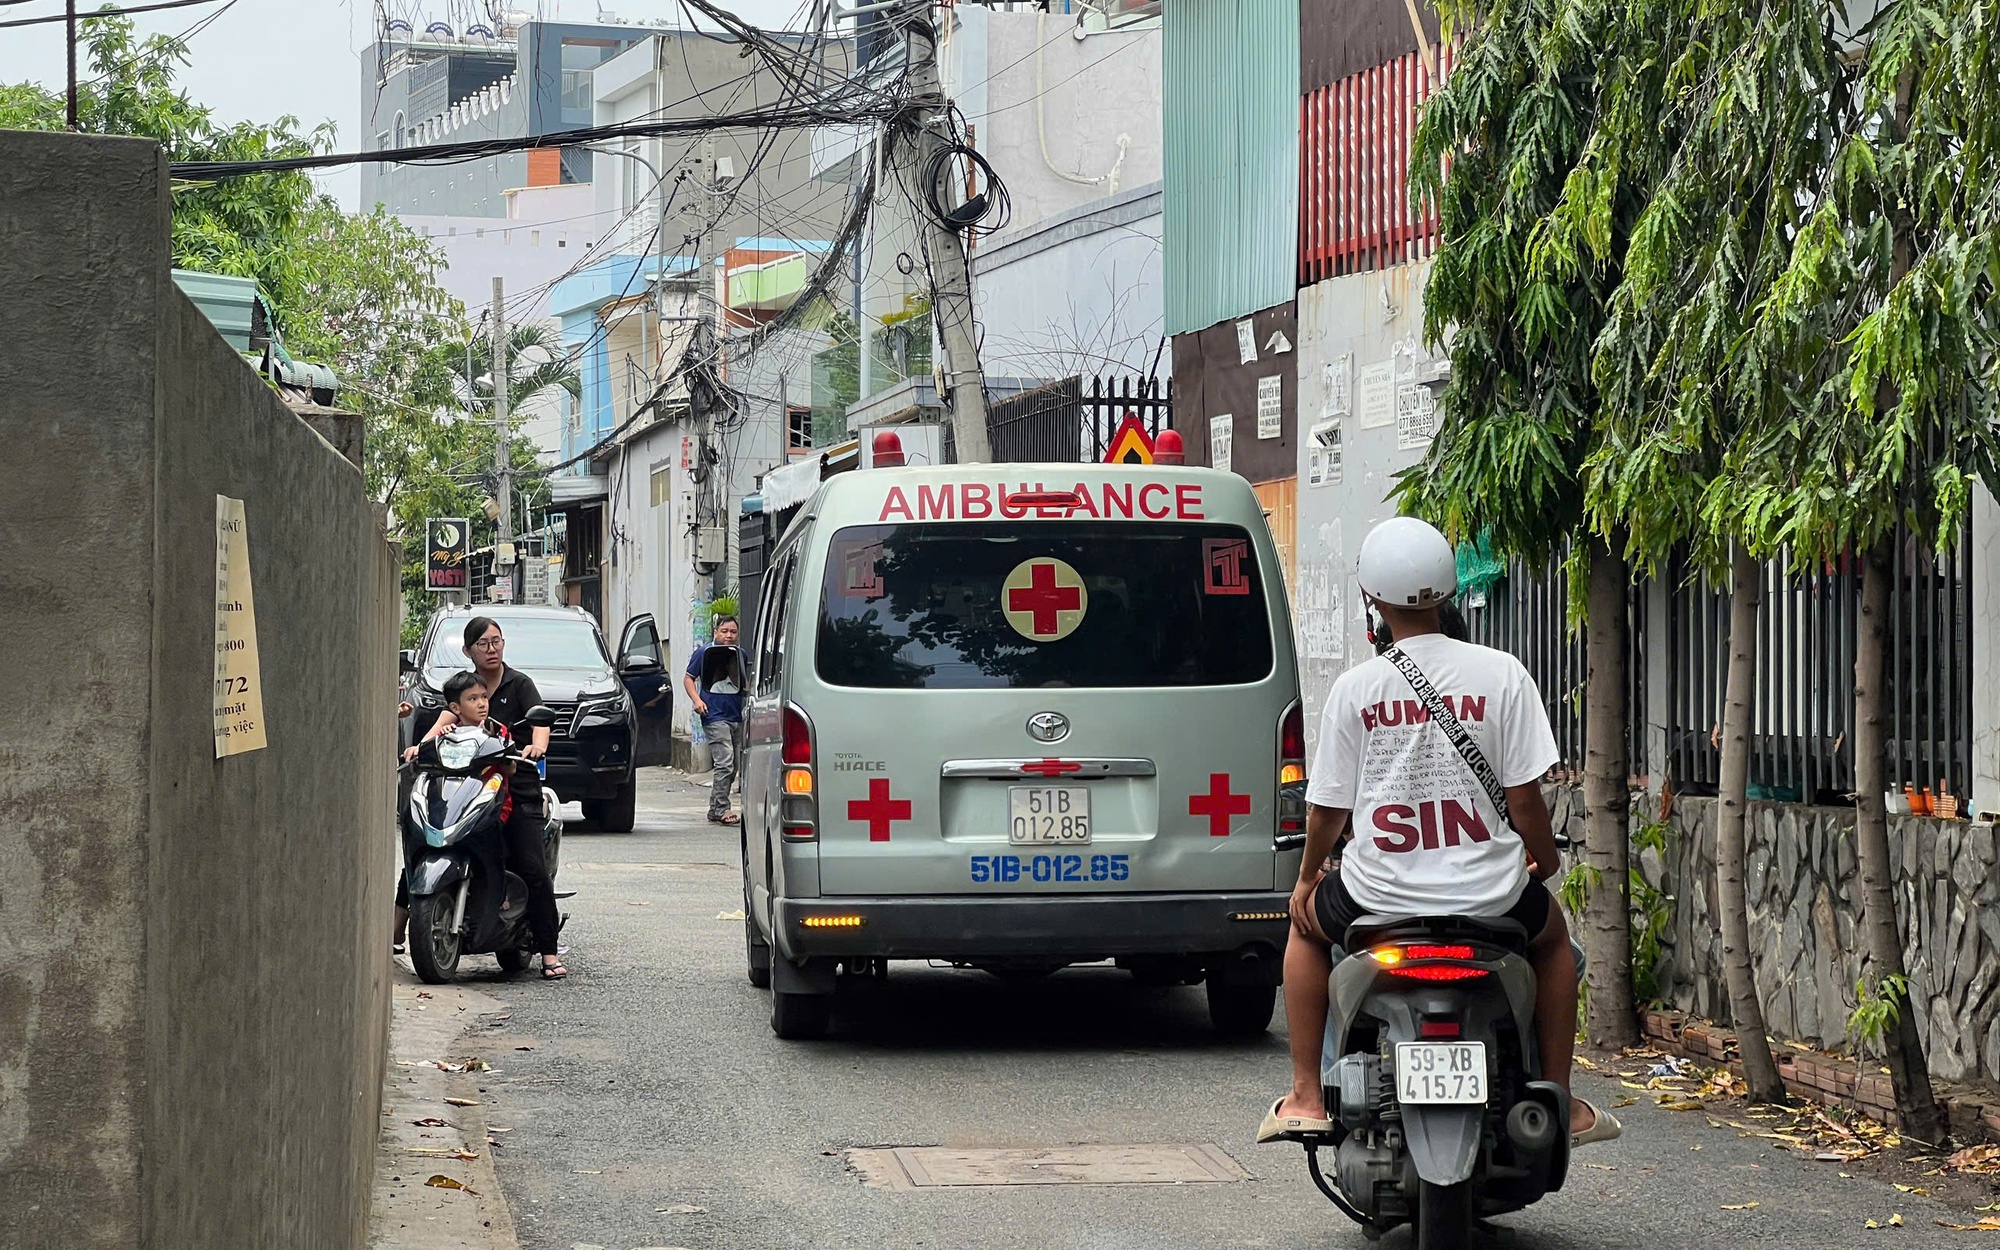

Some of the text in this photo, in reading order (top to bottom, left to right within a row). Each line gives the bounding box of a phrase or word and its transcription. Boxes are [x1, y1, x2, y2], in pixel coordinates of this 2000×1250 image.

[879, 483, 1205, 520] AMBULANCE
[233, 720, 254, 733] việc
[834, 761, 886, 771] HIACE
[1030, 790, 1070, 814] 51B
[1014, 816, 1088, 840] 012.85
[1372, 799, 1491, 853] SIN
[971, 855, 1129, 882] 51B-012.85
[1410, 1048, 1472, 1072] 59-XB
[1406, 1075, 1479, 1099] 415.73
